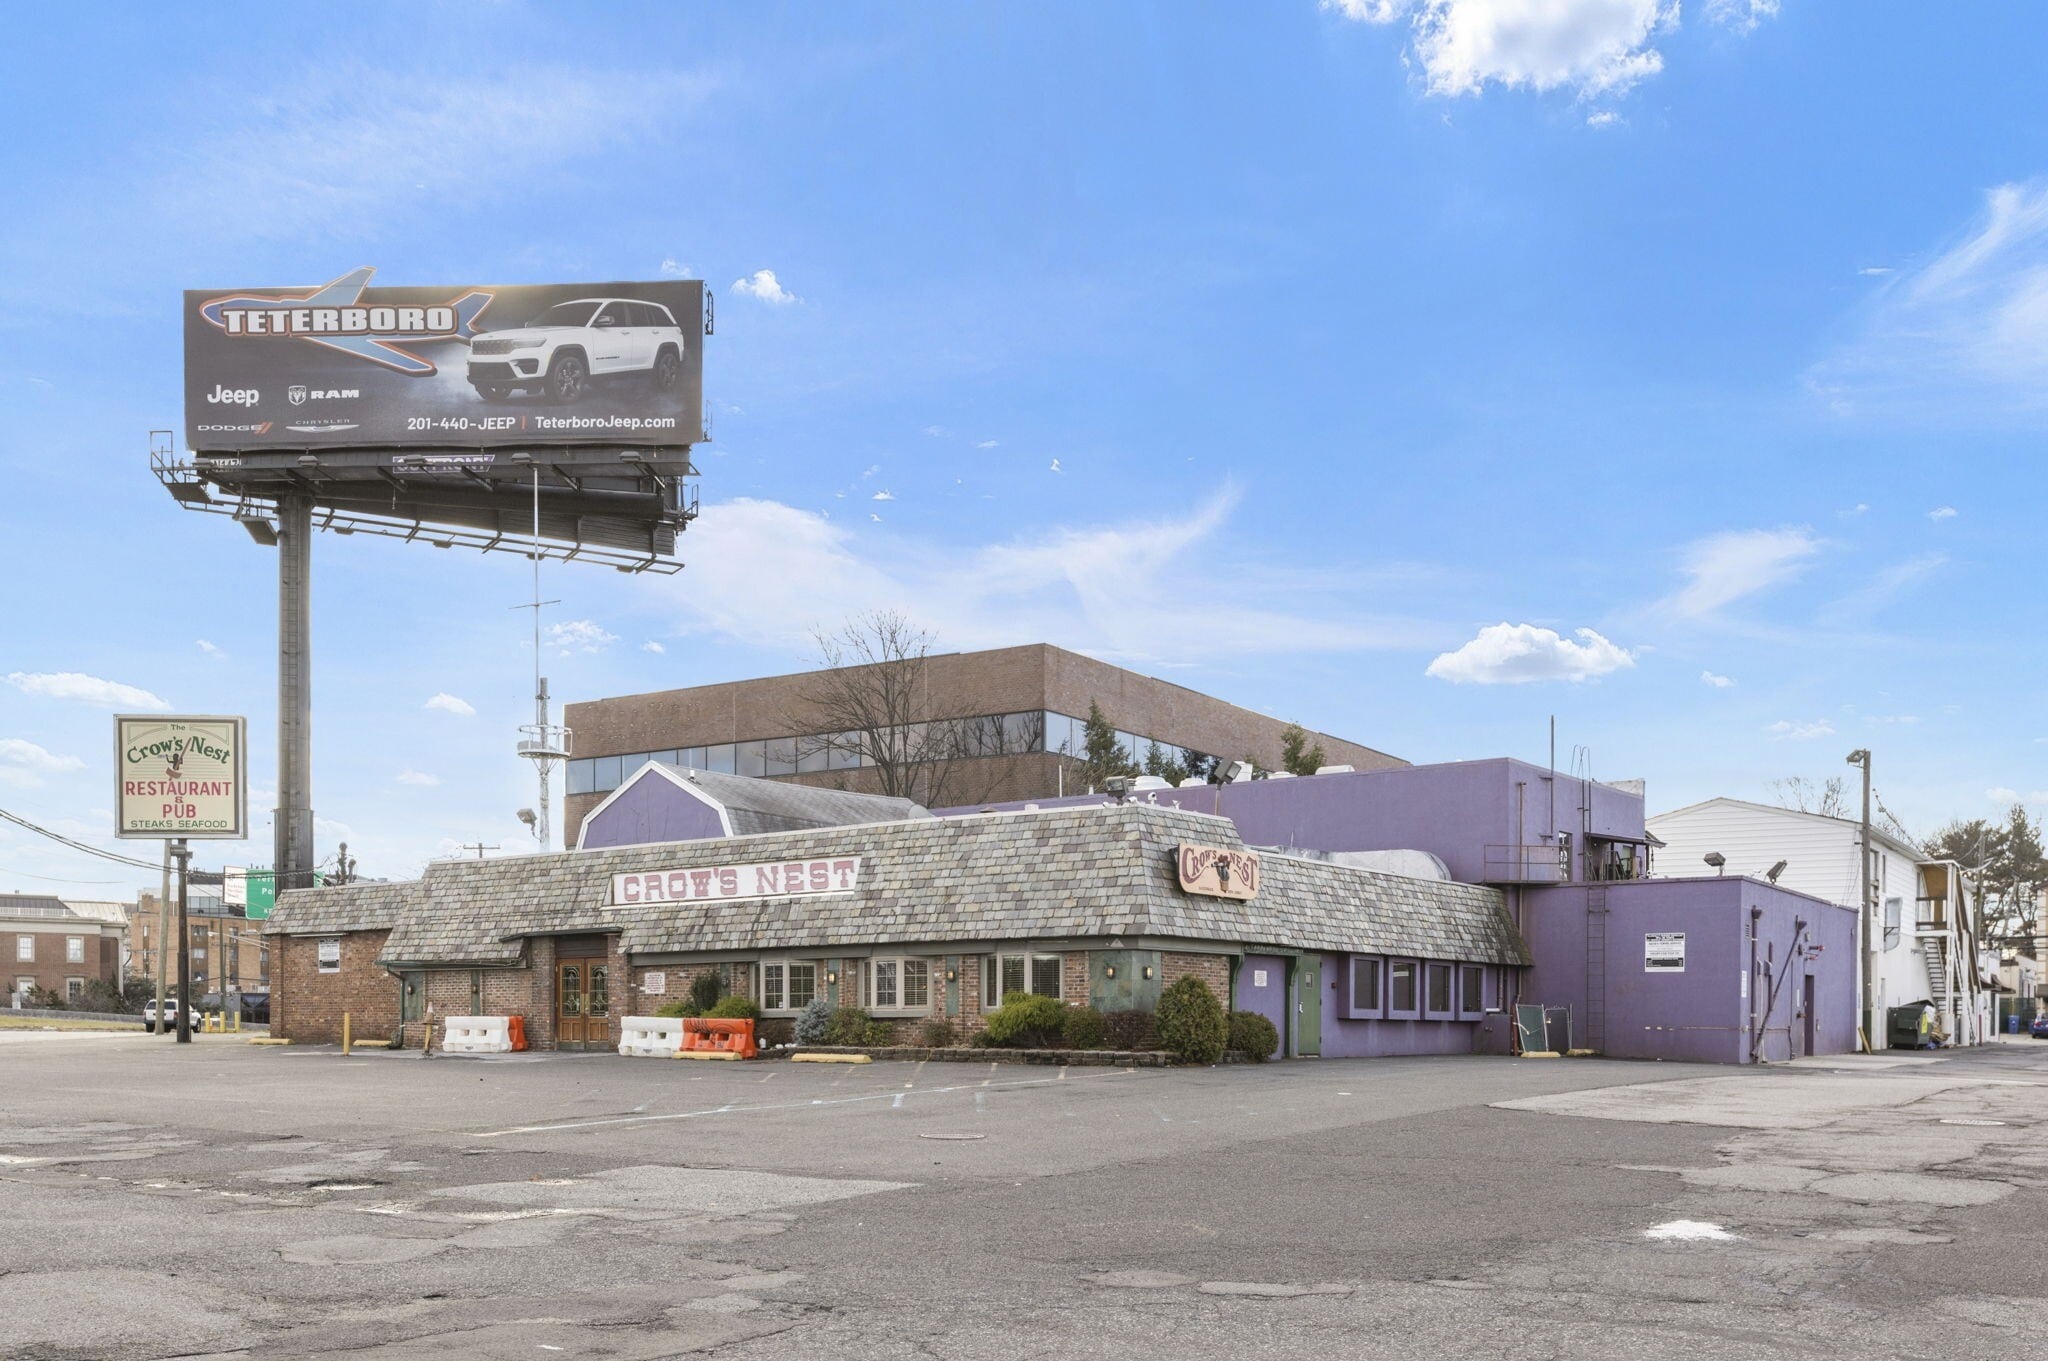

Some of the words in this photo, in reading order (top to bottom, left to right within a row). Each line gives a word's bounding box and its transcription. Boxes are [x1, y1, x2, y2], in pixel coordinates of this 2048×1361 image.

[222, 307, 453, 333] TETERBORO
[207, 384, 260, 408] Jeep
[311, 389, 360, 399] RAM
[407, 417, 516, 430] 201-440-JEEP
[535, 415, 676, 430] TeterboroJeep.com
[127, 736, 183, 764] Crow's
[189, 736, 231, 764] Nest
[125, 781, 232, 796] RESTAURANT
[162, 804, 196, 818] PUB
[131, 820, 173, 828] STEAKS
[178, 820, 228, 828] SEAFOOD
[623, 867, 738, 902] CROW'S
[755, 860, 855, 894] NEST
[1229, 853, 1258, 891] NEST
